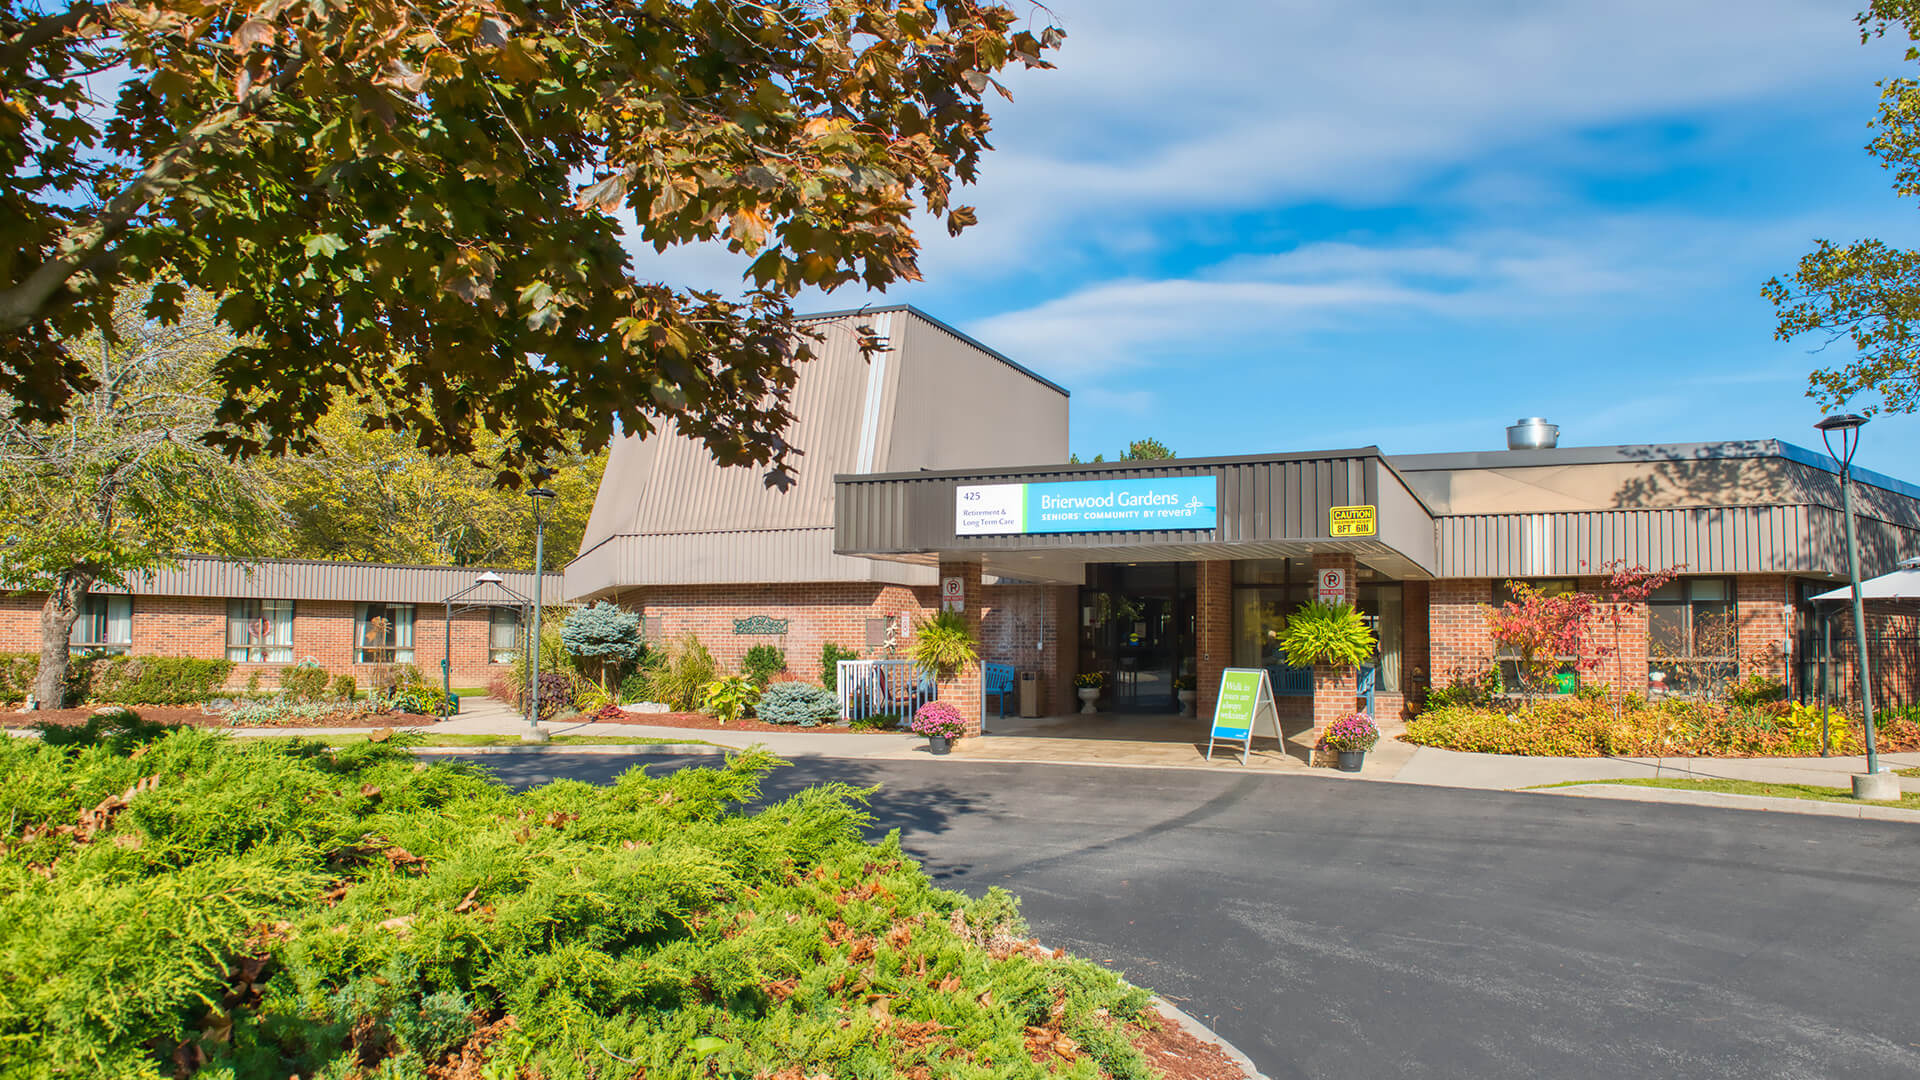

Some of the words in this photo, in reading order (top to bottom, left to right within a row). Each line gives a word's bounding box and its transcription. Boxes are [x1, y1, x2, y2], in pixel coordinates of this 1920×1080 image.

[964, 492, 980, 500] 425
[1041, 491, 1114, 509] Brierwood
[1118, 490, 1179, 506] Gardens
[1083, 511, 1140, 520] COMMUNITY
[1143, 509, 1154, 518] BY
[1157, 509, 1192, 517] revera
[1334, 510, 1372, 519] CAUTION
[963, 520, 980, 528] Long
[1337, 525, 1351, 533] 8FT
